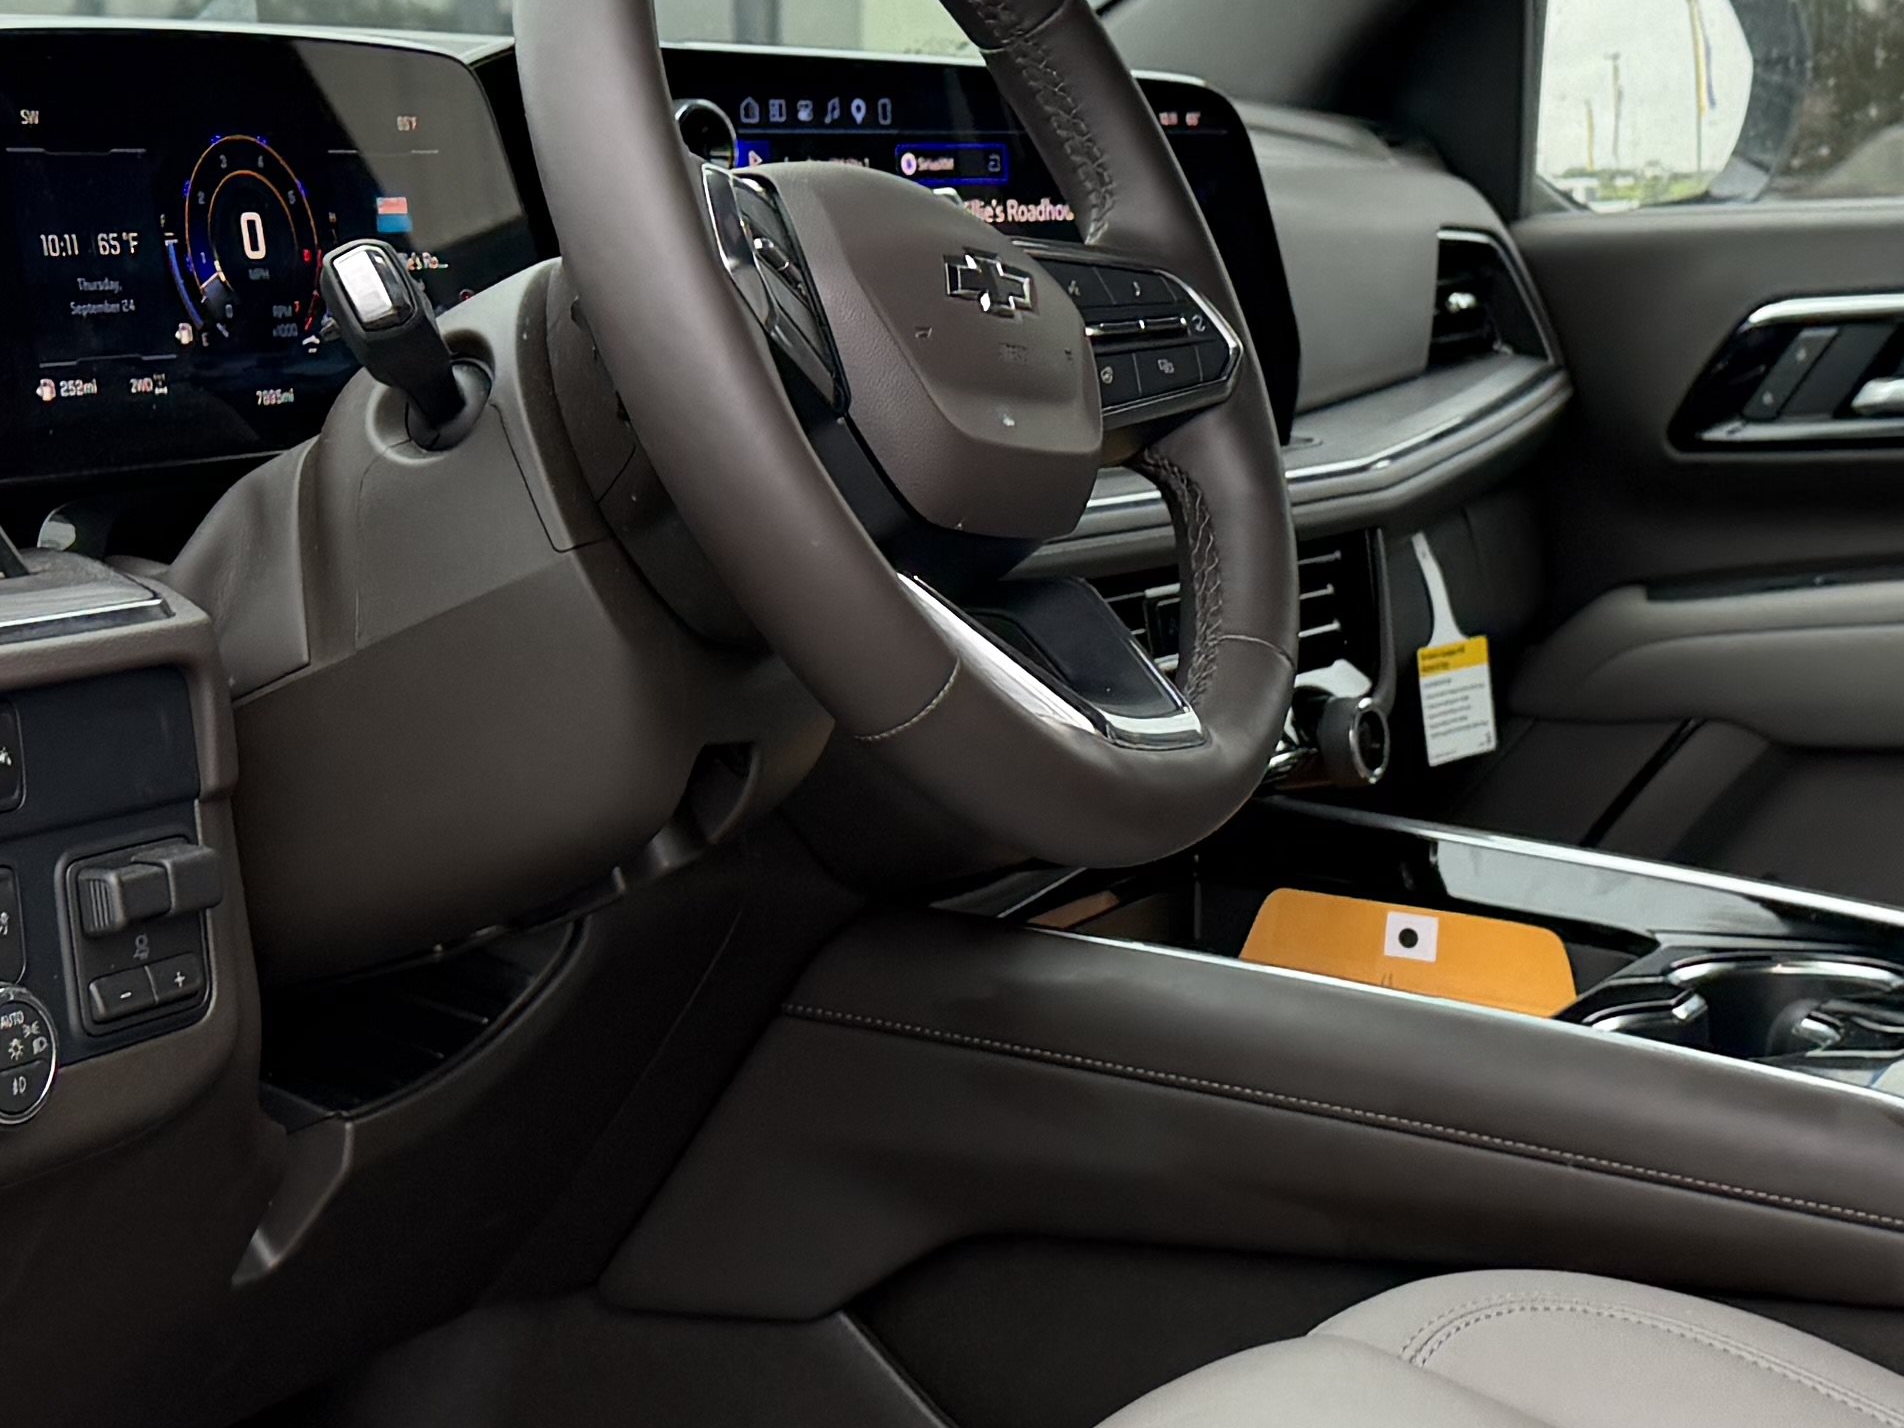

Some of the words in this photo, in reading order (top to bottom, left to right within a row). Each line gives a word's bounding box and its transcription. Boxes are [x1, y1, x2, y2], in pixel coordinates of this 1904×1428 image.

[39, 233, 79, 257] 10:11
[240, 211, 266, 260] 0
[69, 300, 121, 317] September
[0, 1009, 25, 1031] AUTO
